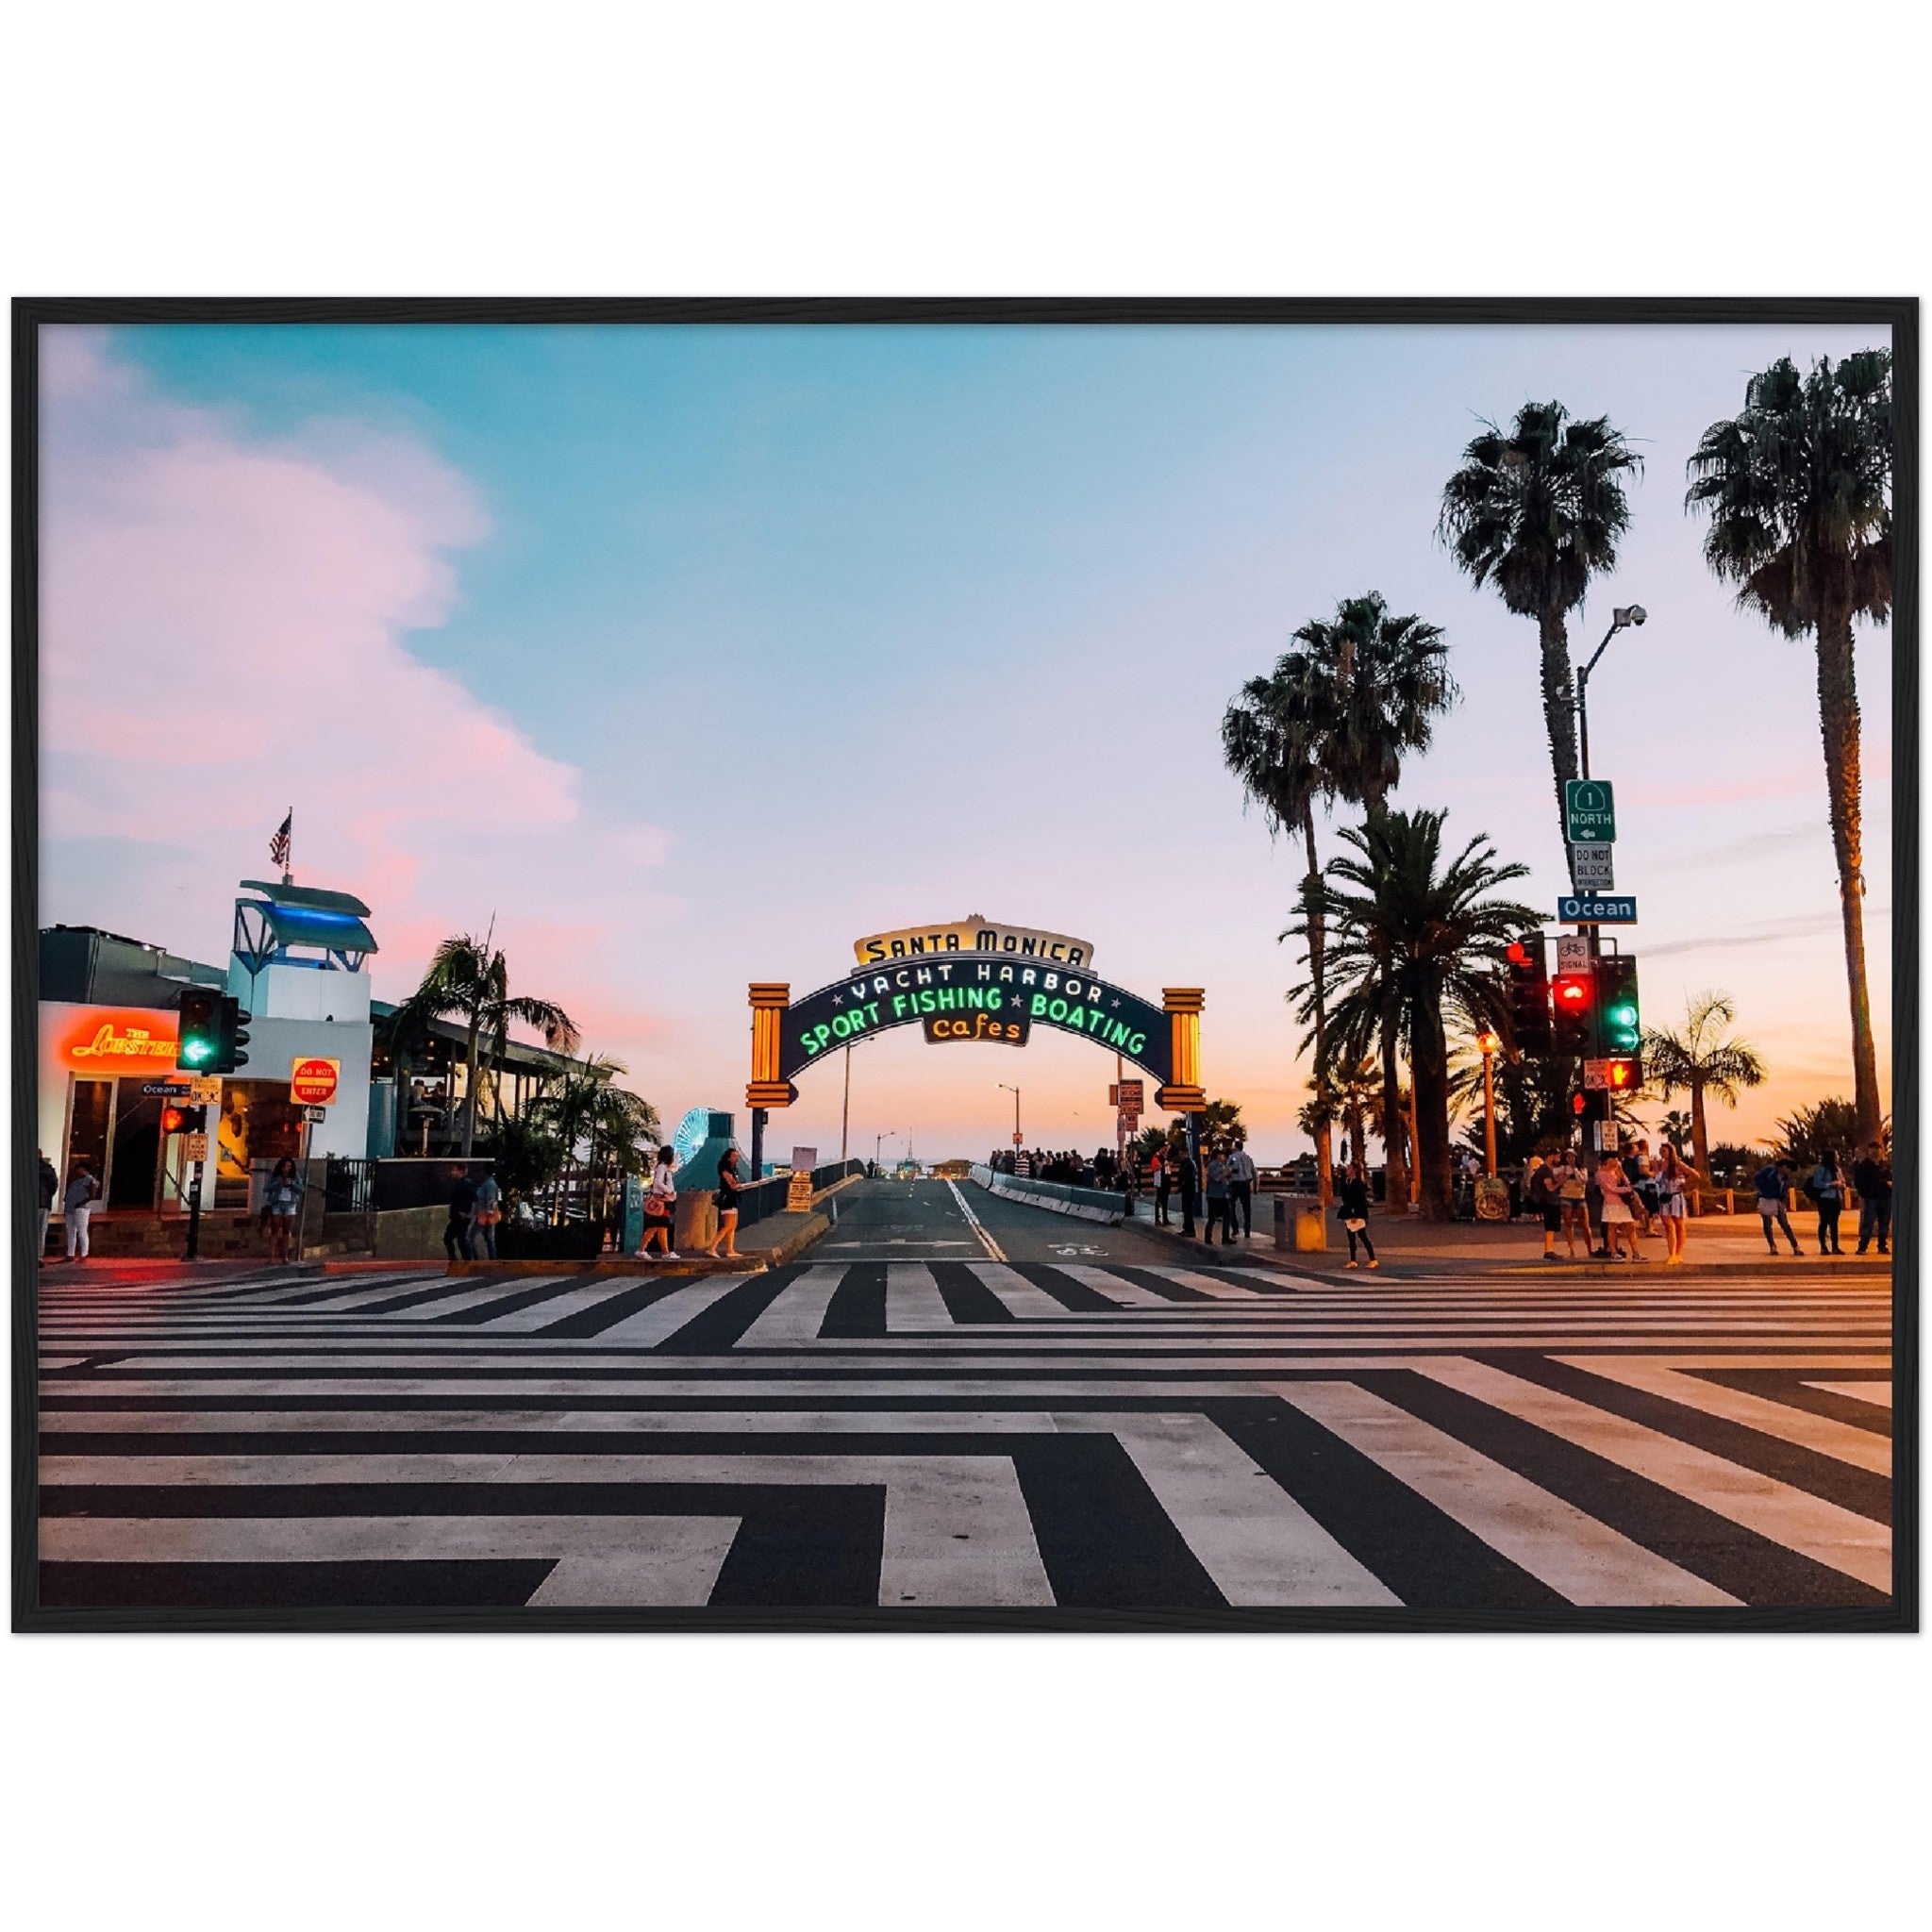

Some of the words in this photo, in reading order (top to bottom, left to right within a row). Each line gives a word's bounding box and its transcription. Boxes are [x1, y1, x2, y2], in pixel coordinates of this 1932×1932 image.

[1588, 792, 1592, 806] 1
[1571, 813, 1611, 825] NORTH
[1576, 850, 1589, 861] DO
[1591, 850, 1609, 861] NOT
[1577, 865, 1611, 875] BLOCK
[1564, 900, 1631, 917] Ocean
[865, 932, 960, 963] SANTA
[975, 929, 1084, 966] MONICA
[1558, 960, 1588, 970] SIGNAL
[851, 964, 953, 1000] YACHT
[977, 964, 1103, 1003] HARBOR
[800, 1002, 879, 1056] SPORT
[892, 987, 1003, 1019] FISHING
[1031, 993, 1147, 1056] BOATING
[932, 1013, 1022, 1041] cafes
[125, 1027, 150, 1039] THE
[300, 1067, 312, 1075] DO
[143, 1085, 176, 1093] Ocean
